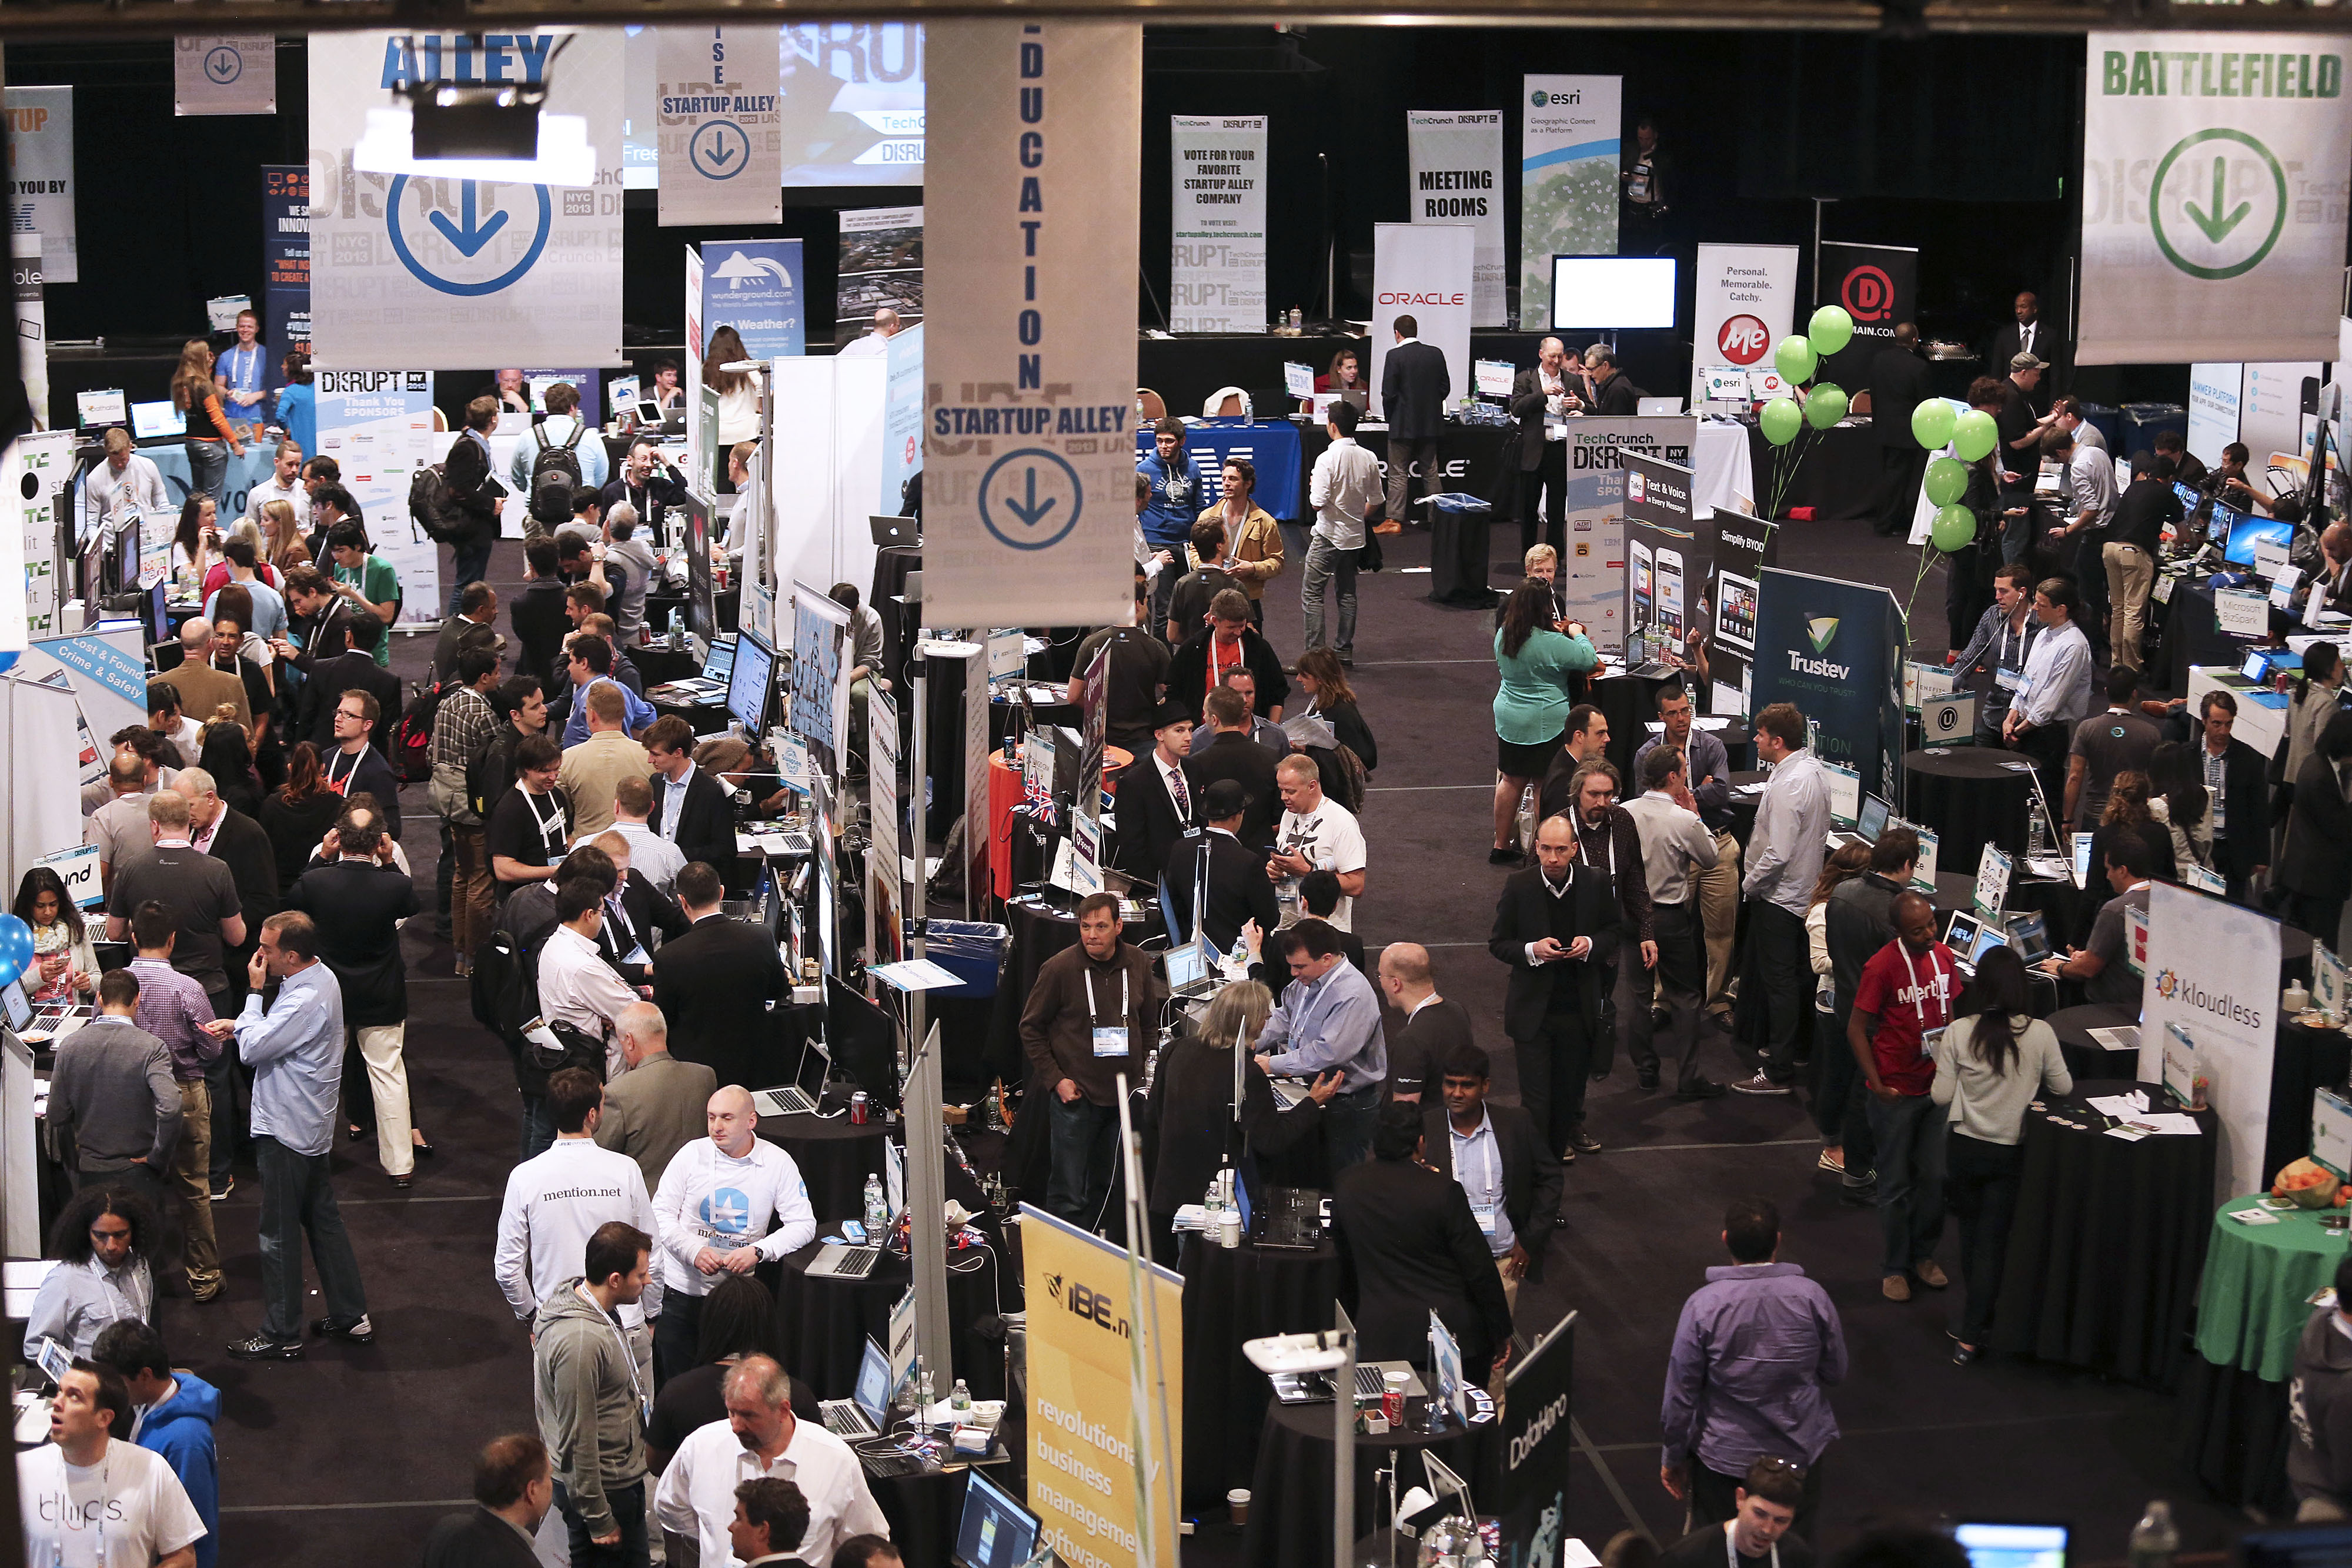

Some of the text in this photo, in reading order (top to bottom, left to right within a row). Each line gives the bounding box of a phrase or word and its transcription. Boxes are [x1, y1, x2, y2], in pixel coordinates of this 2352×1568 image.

[380, 35, 553, 88] ALLEY
[2102, 51, 2342, 98] BATTLEFIELD
[1551, 89, 1581, 105] esri
[663, 96, 775, 113] STARTUP ALLEY
[6, 108, 48, 132] TUP
[1223, 120, 1252, 128] DISRUPT
[1458, 115, 1488, 123] DISRUPT
[1531, 118, 1568, 128] Geographic
[1184, 150, 1254, 161] VOTE FOR YOUR
[1197, 165, 1241, 175] FAVORITE
[19, 180, 66, 194] YOU BY
[1184, 179, 1254, 189] STARTUP ALLEY
[1419, 170, 1492, 190] MEETING
[566, 192, 591, 202] NYC
[1196, 193, 1242, 204] COMPANY
[565, 203, 591, 213] 2013
[1019, 25, 1043, 389] DUCATION
[1426, 197, 1487, 217] ROOMS
[335, 237, 369, 248] NYC
[334, 251, 369, 263] 2013
[1174, 245, 1231, 267] RUPT
[14, 269, 42, 285] ble
[271, 272, 279, 282] TO
[280, 272, 303, 282] CREATE
[1726, 267, 1768, 277] Personal.
[1720, 279, 1772, 290] Memorable.
[711, 290, 793, 300] wunderground.com
[1174, 283, 1231, 306] RUPT
[1378, 293, 1465, 305] ORACLE
[1729, 293, 1762, 303] Catchy.
[737, 318, 796, 329] Weather?
[1173, 317, 1231, 333] RUPT
[322, 371, 401, 392] DISRUPT
[1479, 375, 1509, 383] ORACLE
[1723, 378, 1740, 387] esri
[345, 397, 405, 406] Thank You
[344, 407, 405, 416] SPONSORS
[935, 406, 1127, 435] STARTUP ALLEY
[1575, 433, 1653, 444] TechCrunch
[1598, 475, 1623, 485] Tha
[1646, 479, 1686, 500] Text & Voice
[1652, 496, 1665, 509] Every
[1666, 500, 1686, 514] Message
[1604, 538, 1621, 546] IBM
[1721, 530, 1764, 553] Simplify BYOD
[2223, 600, 2261, 614] Microsoft
[2223, 611, 2258, 625] BizSpark
[1603, 643, 1621, 651] startup
[72, 637, 145, 680] Lost & Found
[1788, 650, 1850, 680] Trustev
[59, 646, 143, 698] Crime & Safety
[1778, 677, 1857, 697] WHO CAN YOU TRUST?
[1756, 759, 1776, 771] PR
[74, 847, 92, 857] DISRUPT
[2181, 978, 2261, 1029] kloudless
[543, 1187, 622, 1202] mention.net
[1509, 1393, 1568, 1470] DataHero
[1037, 1397, 1160, 1483] revolutionay
[1037, 1432, 1112, 1496] business
[1037, 1479, 1135, 1552] manageme
